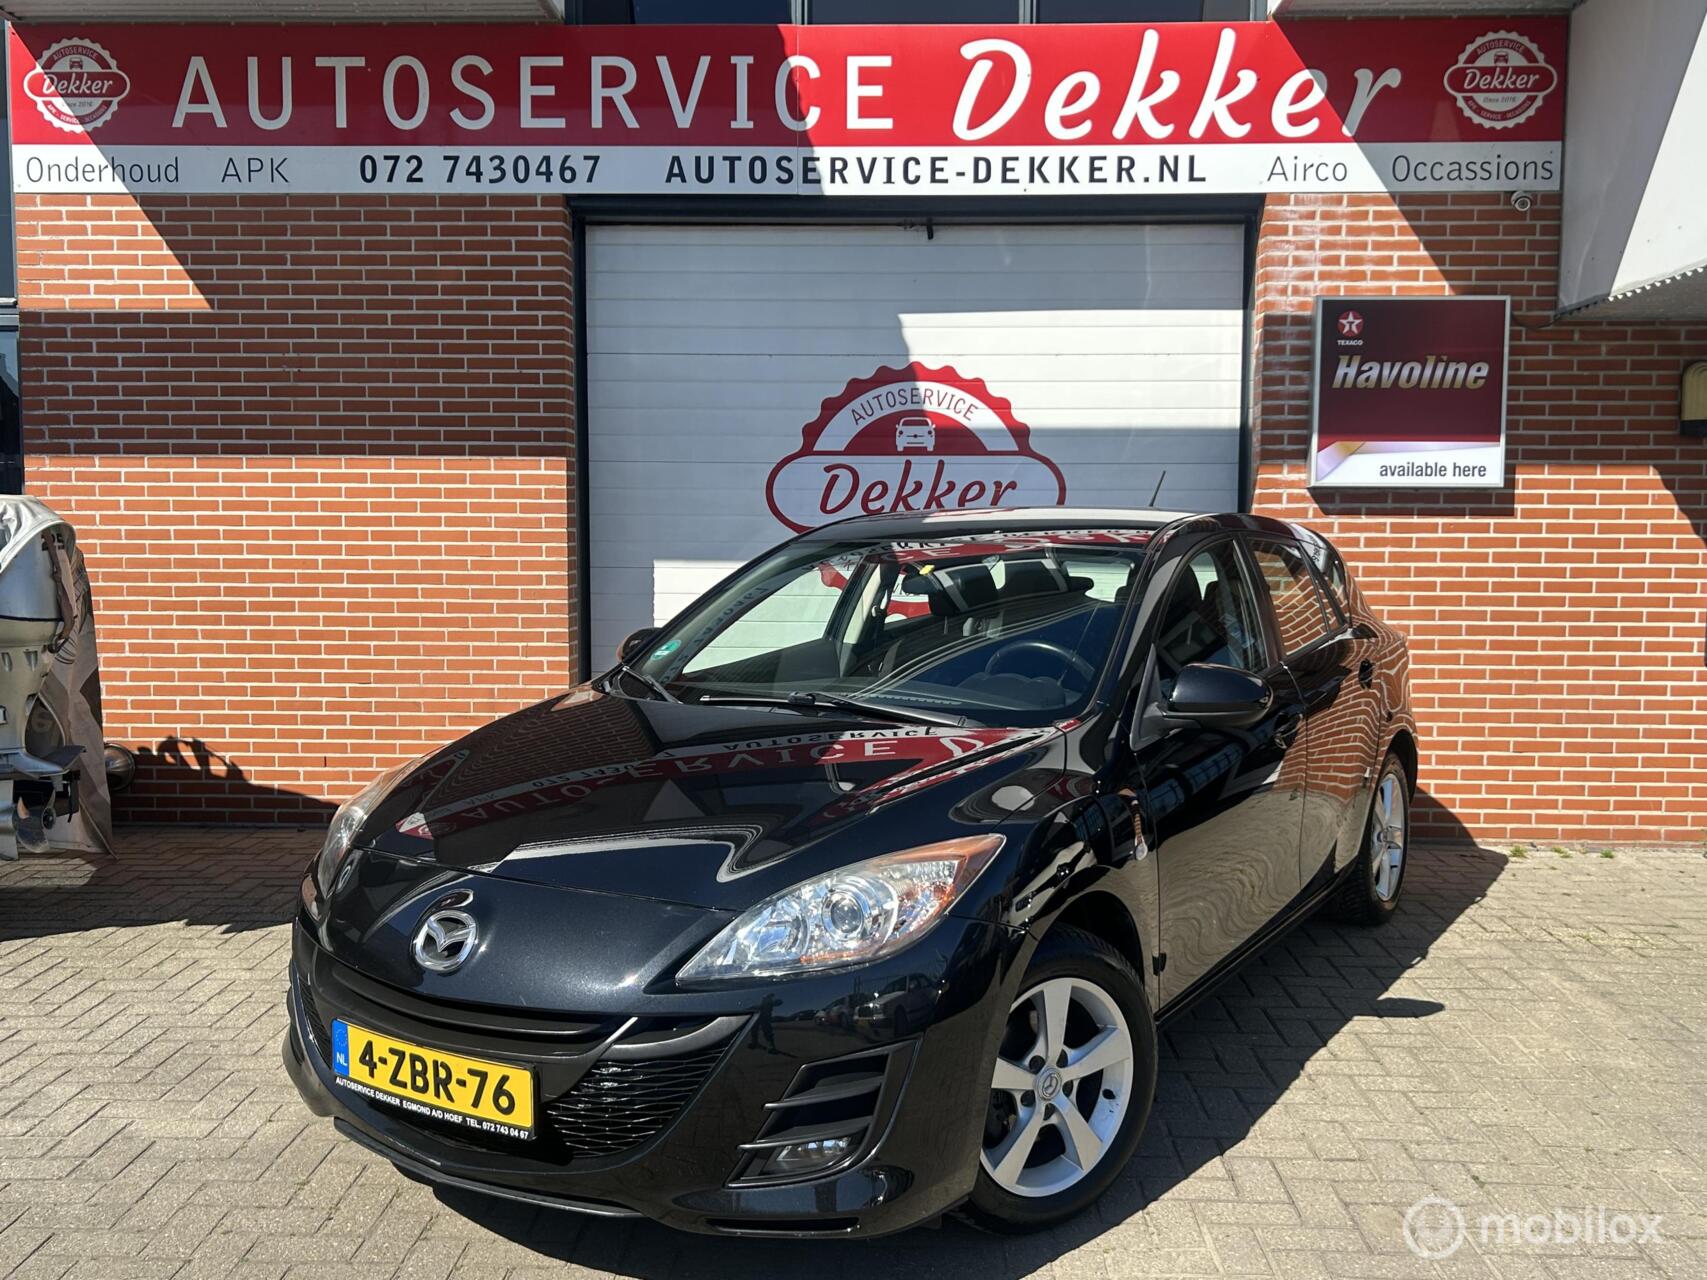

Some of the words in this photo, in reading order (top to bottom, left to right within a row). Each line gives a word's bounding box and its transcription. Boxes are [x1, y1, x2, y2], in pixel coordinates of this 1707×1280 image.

[52, 46, 99, 61] AUTOSERVICE
[1476, 39, 1525, 54] AUTOSERVICE
[42, 72, 113, 94] Dekker
[172, 55, 894, 131] AUTOSERVICE
[952, 27, 1402, 141] Dekker
[1463, 66, 1540, 90] Dekker
[26, 156, 180, 184] Onderhoud
[221, 157, 291, 184] APK
[359, 154, 425, 185] 072
[443, 154, 601, 185] 7430467
[665, 154, 1207, 185] AUTOSERVICE-DEKKER.NL
[1267, 155, 1348, 183] Airco
[1392, 154, 1554, 182] Occassions
[1332, 354, 1490, 390] Havoline
[850, 387, 979, 426] AUTOSERVICE
[1379, 462, 1447, 478] available
[1453, 462, 1487, 478] here
[820, 459, 1018, 515] Dekker
[336, 1052, 348, 1066] NL
[358, 1039, 516, 1116] 4-ZBR-76
[336, 1076, 374, 1097] AUTOSERVICE
[375, 1090, 401, 1106] DEKKER
[402, 1100, 430, 1115] EGMOND
[444, 1112, 463, 1124] HOEF
[466, 1117, 481, 1128] TEL.
[482, 1121, 495, 1132] 072
[496, 1124, 509, 1135] 743
[509, 1128, 519, 1137] 04
[519, 1130, 529, 1139] 67
